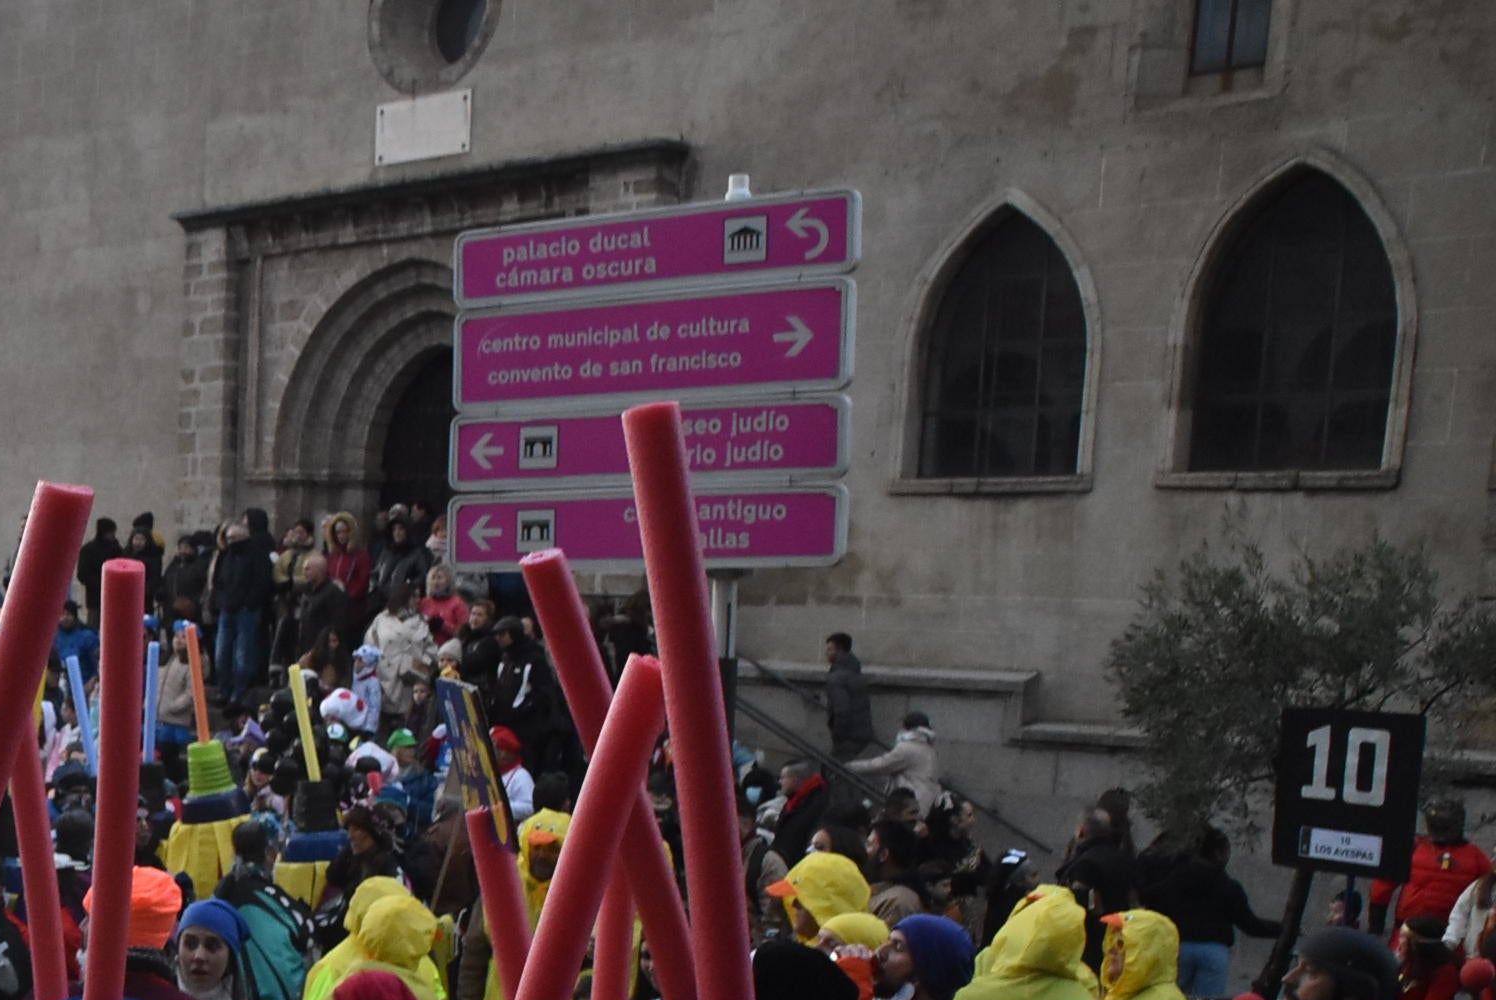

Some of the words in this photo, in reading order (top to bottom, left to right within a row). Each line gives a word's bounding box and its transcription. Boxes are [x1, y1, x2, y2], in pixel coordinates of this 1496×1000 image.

[503, 236, 580, 266] palacio
[589, 226, 651, 252] ducal
[496, 266, 573, 287] cámara
[582, 257, 656, 280] oscura
[482, 333, 541, 354] centro
[547, 323, 640, 348] municipal
[646, 321, 671, 340] de
[677, 317, 750, 338] cultura
[488, 364, 573, 385] convento
[579, 359, 602, 378] de
[609, 358, 643, 376] san
[650, 350, 742, 372] francisco
[682, 417, 722, 435] seo
[730, 410, 790, 437] judío
[687, 443, 717, 464] rio
[724, 440, 784, 467] judío
[699, 498, 787, 524] antiguo
[699, 528, 750, 549] allas
[1301, 723, 1391, 807] 10
